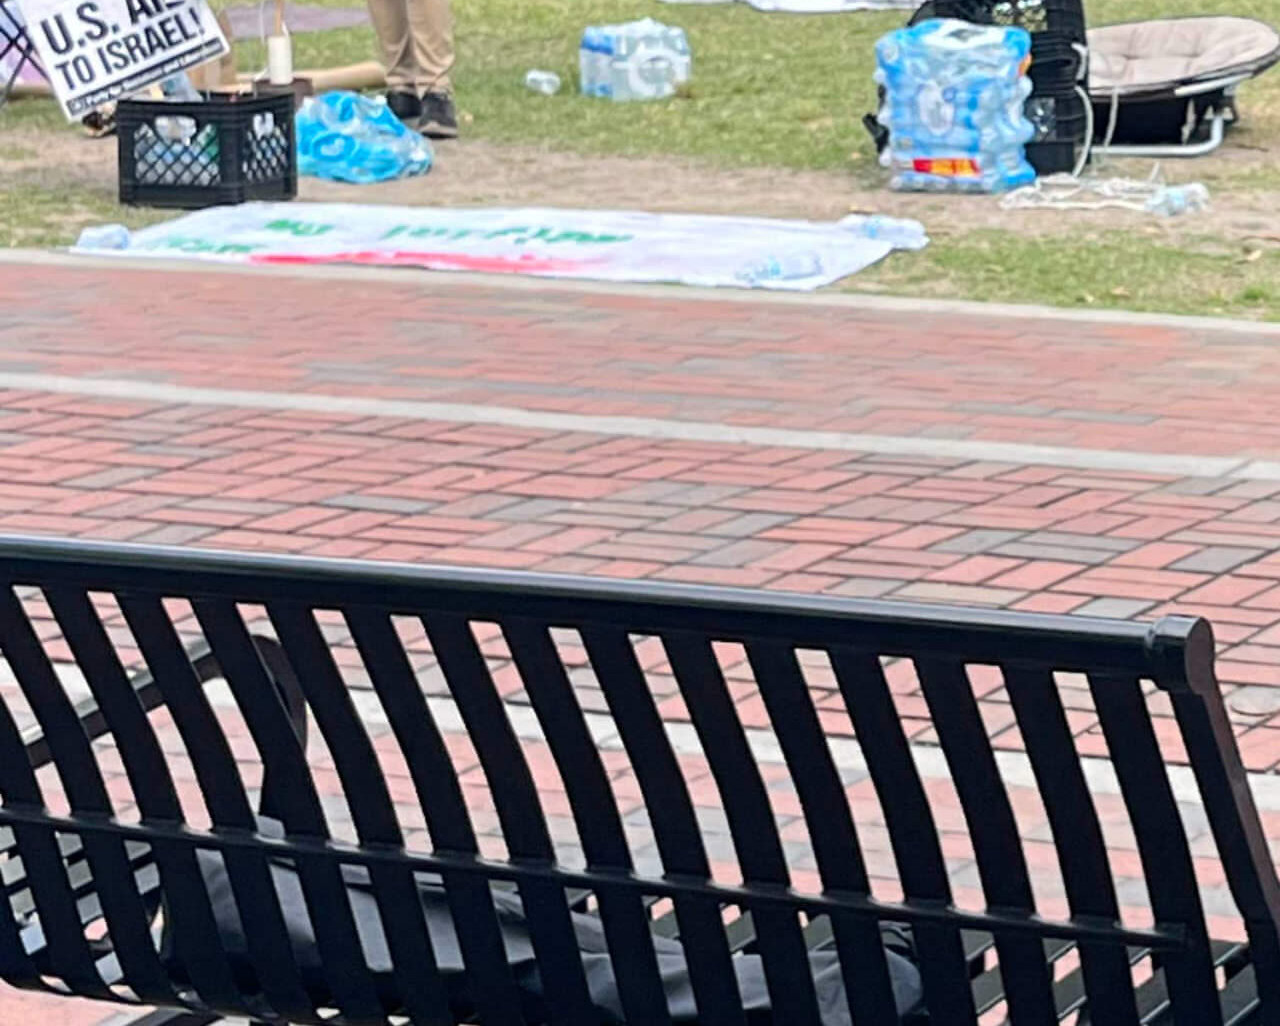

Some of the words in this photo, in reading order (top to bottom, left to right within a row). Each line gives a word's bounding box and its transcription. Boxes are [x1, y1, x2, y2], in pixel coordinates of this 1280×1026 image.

[40, 0, 121, 56] U.S.
[54, 54, 97, 91] TO
[96, 6, 206, 75] ISRAEL!
